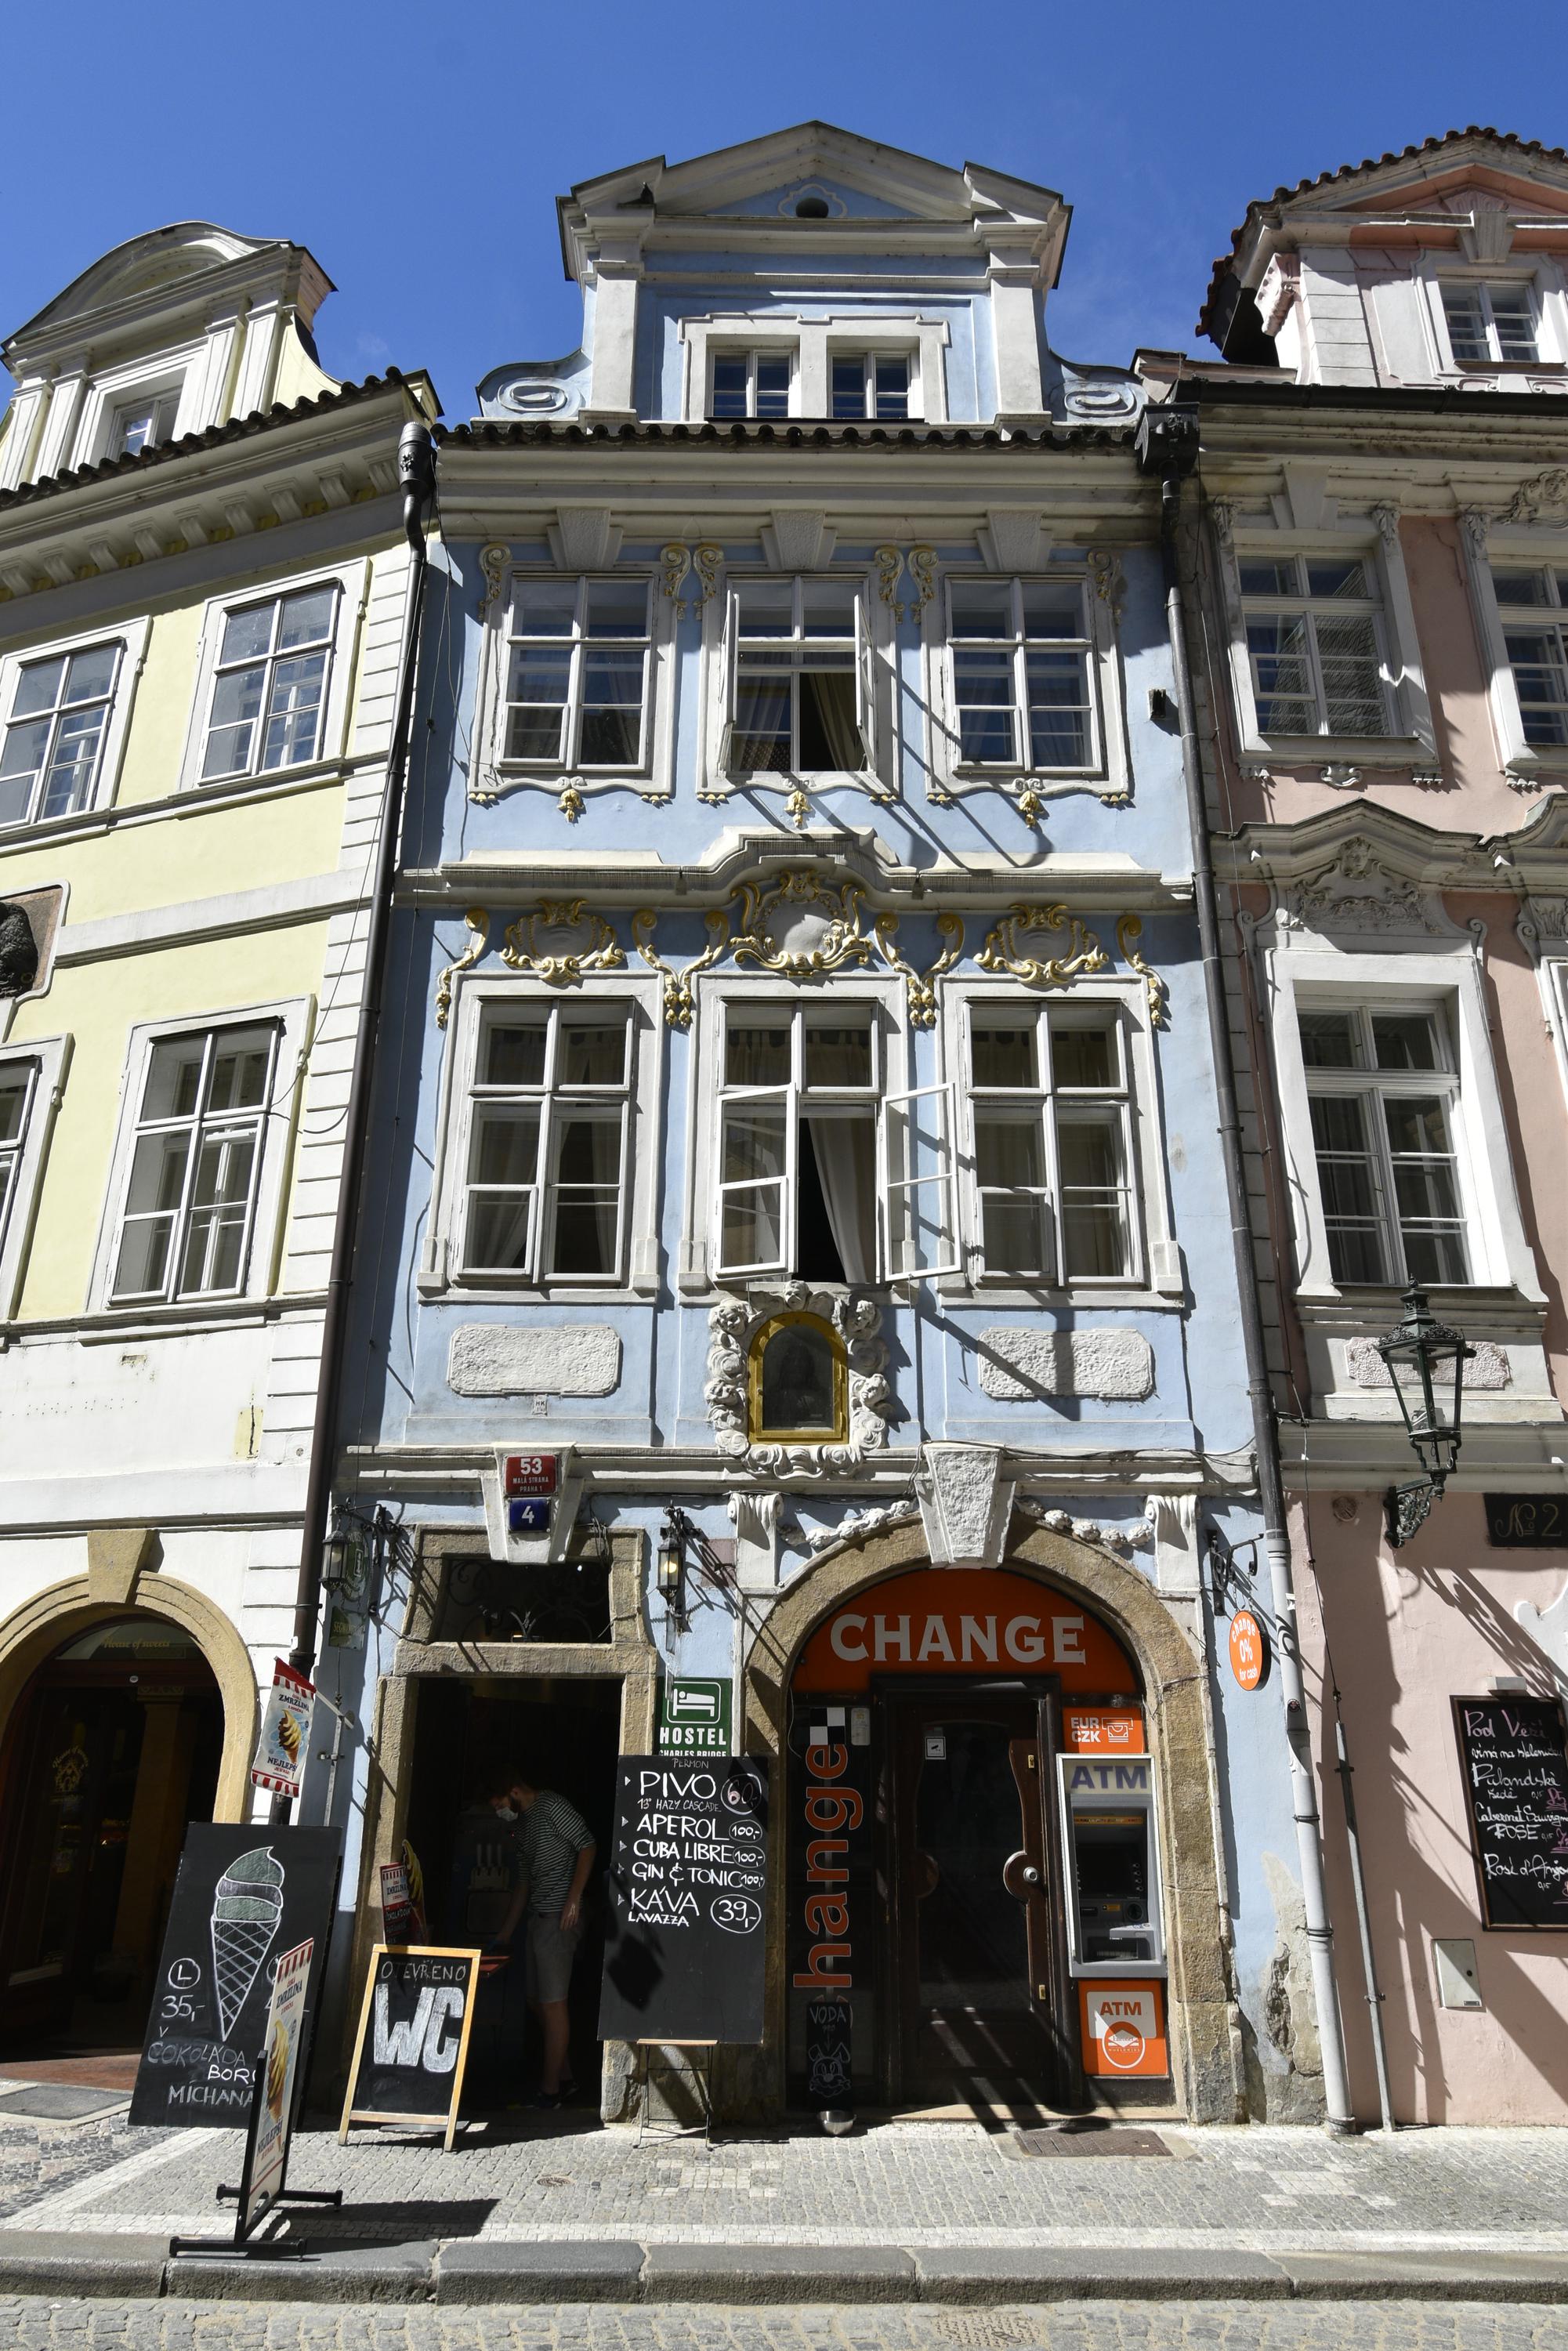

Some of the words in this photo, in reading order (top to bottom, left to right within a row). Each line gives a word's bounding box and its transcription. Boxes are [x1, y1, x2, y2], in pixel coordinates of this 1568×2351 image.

[520, 1458, 542, 1475] 53
[512, 1476, 527, 1484] MALÁ
[521, 1505, 535, 1524] 4
[1541, 1503, 1562, 1537] 2
[831, 1614, 1086, 1666] CHANGE
[1231, 1617, 1256, 1643] change
[1239, 1637, 1253, 1663] 0%
[1247, 1665, 1258, 1679] cash
[1070, 1717, 1099, 1729] EUR
[1465, 1709, 1496, 1738] Pod
[659, 1726, 726, 1745] HOSTEL
[1071, 1730, 1101, 1742] CZK
[672, 1757, 709, 1769] PERMON
[639, 1770, 717, 1799] PIVO
[1070, 1766, 1147, 1789] ATM
[656, 1799, 678, 1810] HAZY
[683, 1799, 722, 1813] CASCADE
[636, 1813, 730, 1842] APEROL
[633, 1838, 680, 1860] CUBA
[684, 1842, 735, 1864] LIBRE
[632, 1862, 664, 1881] GIN
[687, 1867, 742, 1889] TONIC
[793, 1743, 863, 1989] hange
[630, 1886, 700, 1916] KÁVA
[628, 1911, 690, 1927] LAVAZZA
[177, 1965, 192, 1981] L
[809, 2005, 847, 2024] VODA
[1100, 2001, 1142, 2016] ATM
[374, 1983, 465, 2073] WC
[147, 2026, 246, 2067] ČOKOLÁDA
[208, 2064, 255, 2085] BOR
